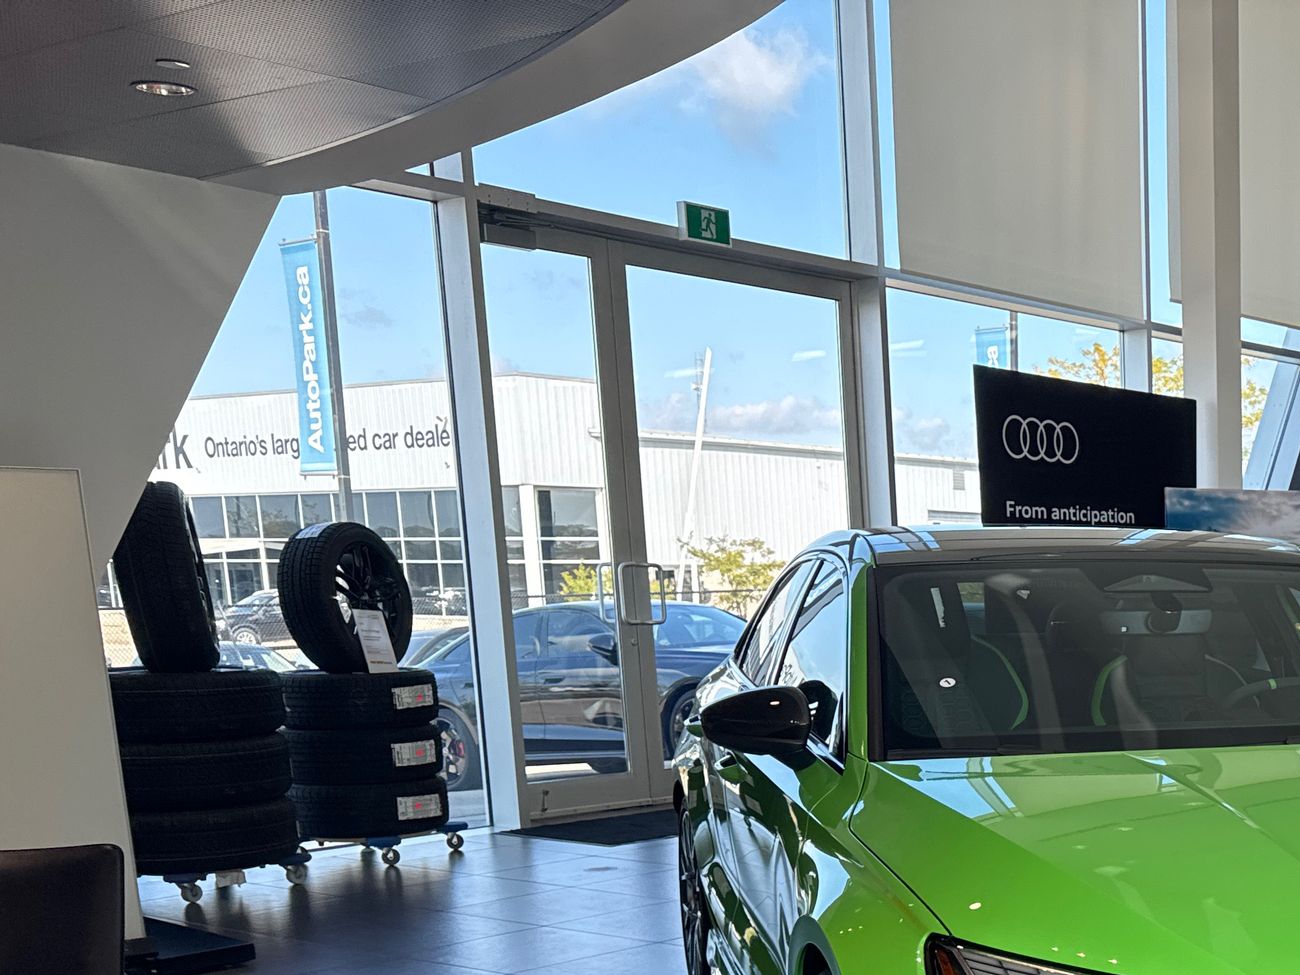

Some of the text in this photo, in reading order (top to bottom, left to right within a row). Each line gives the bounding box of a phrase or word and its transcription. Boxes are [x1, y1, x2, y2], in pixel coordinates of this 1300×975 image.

[296, 265, 325, 454] AutoPark.ca
[204, 434, 268, 459] Ontario's
[372, 431, 398, 451] car
[1005, 500, 1135, 525] From anticipation
